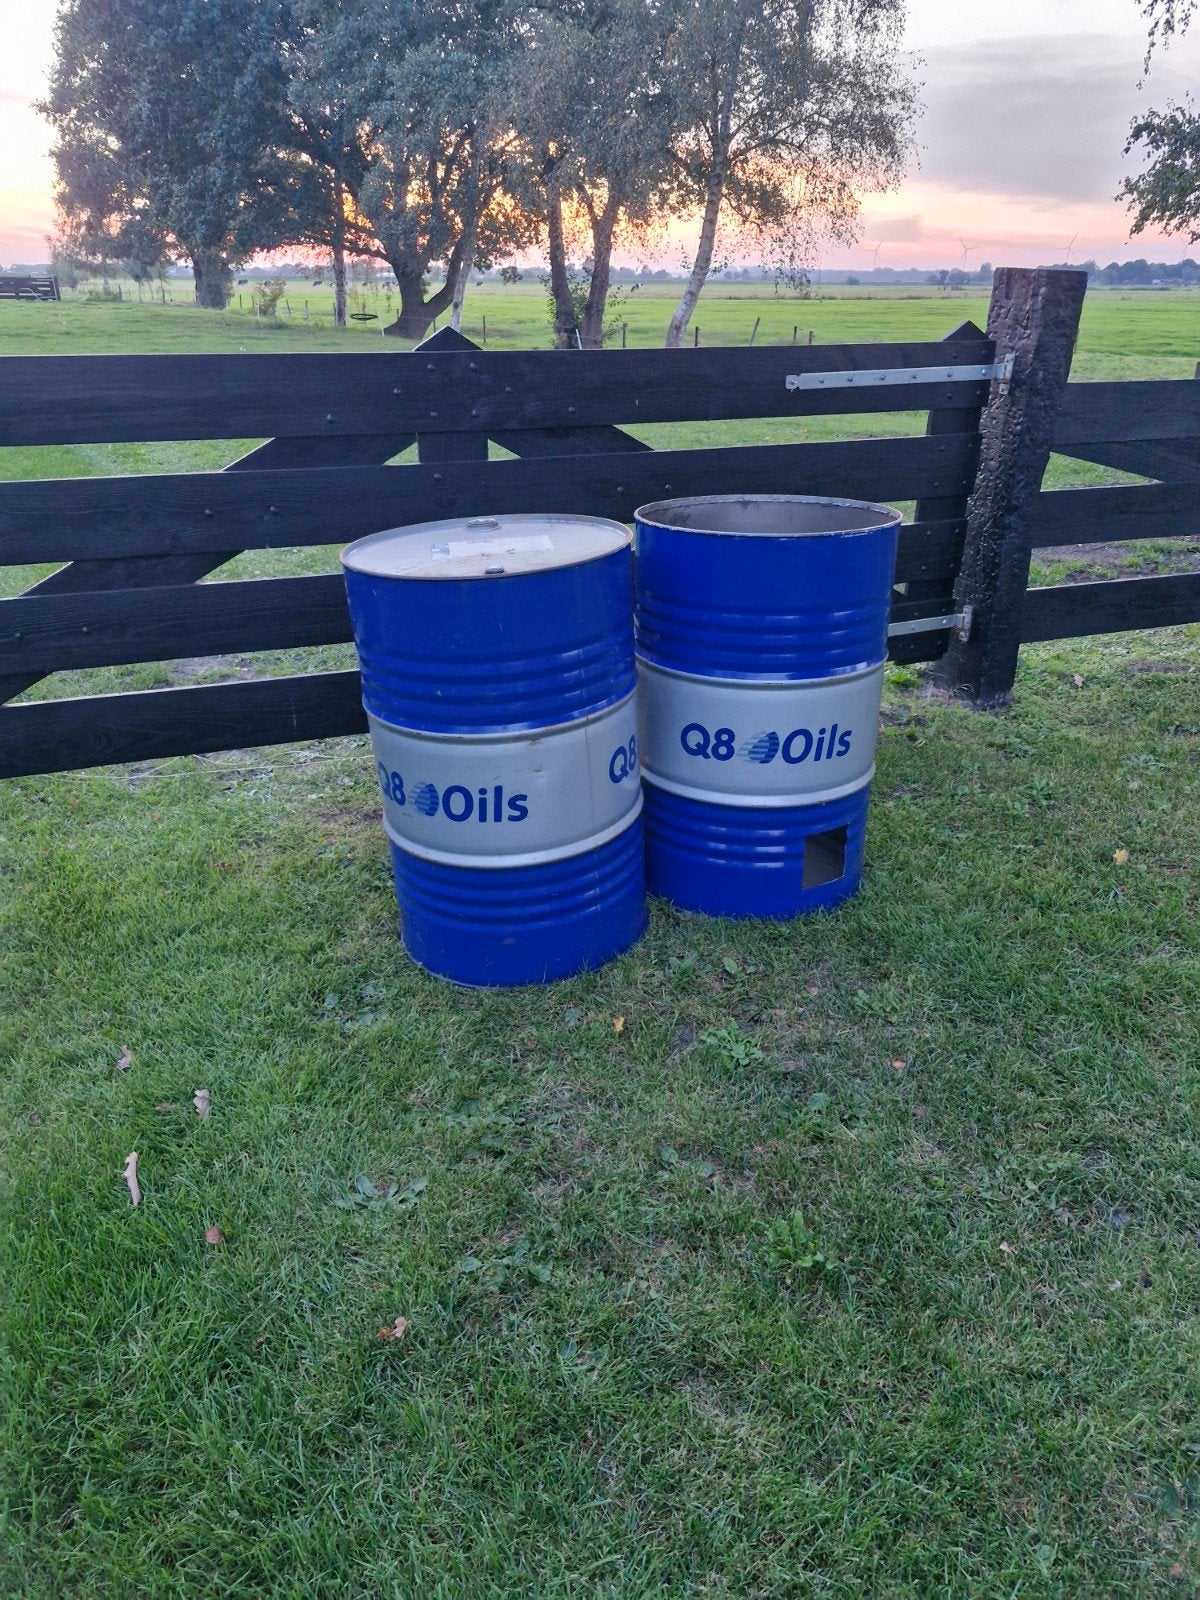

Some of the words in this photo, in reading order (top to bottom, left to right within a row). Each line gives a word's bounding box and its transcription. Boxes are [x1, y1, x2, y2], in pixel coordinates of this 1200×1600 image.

[609, 734, 637, 784] Q8
[680, 722, 736, 762] Q8
[781, 723, 853, 765] Oils
[377, 761, 407, 806] Q8
[441, 784, 529, 823] Oils
